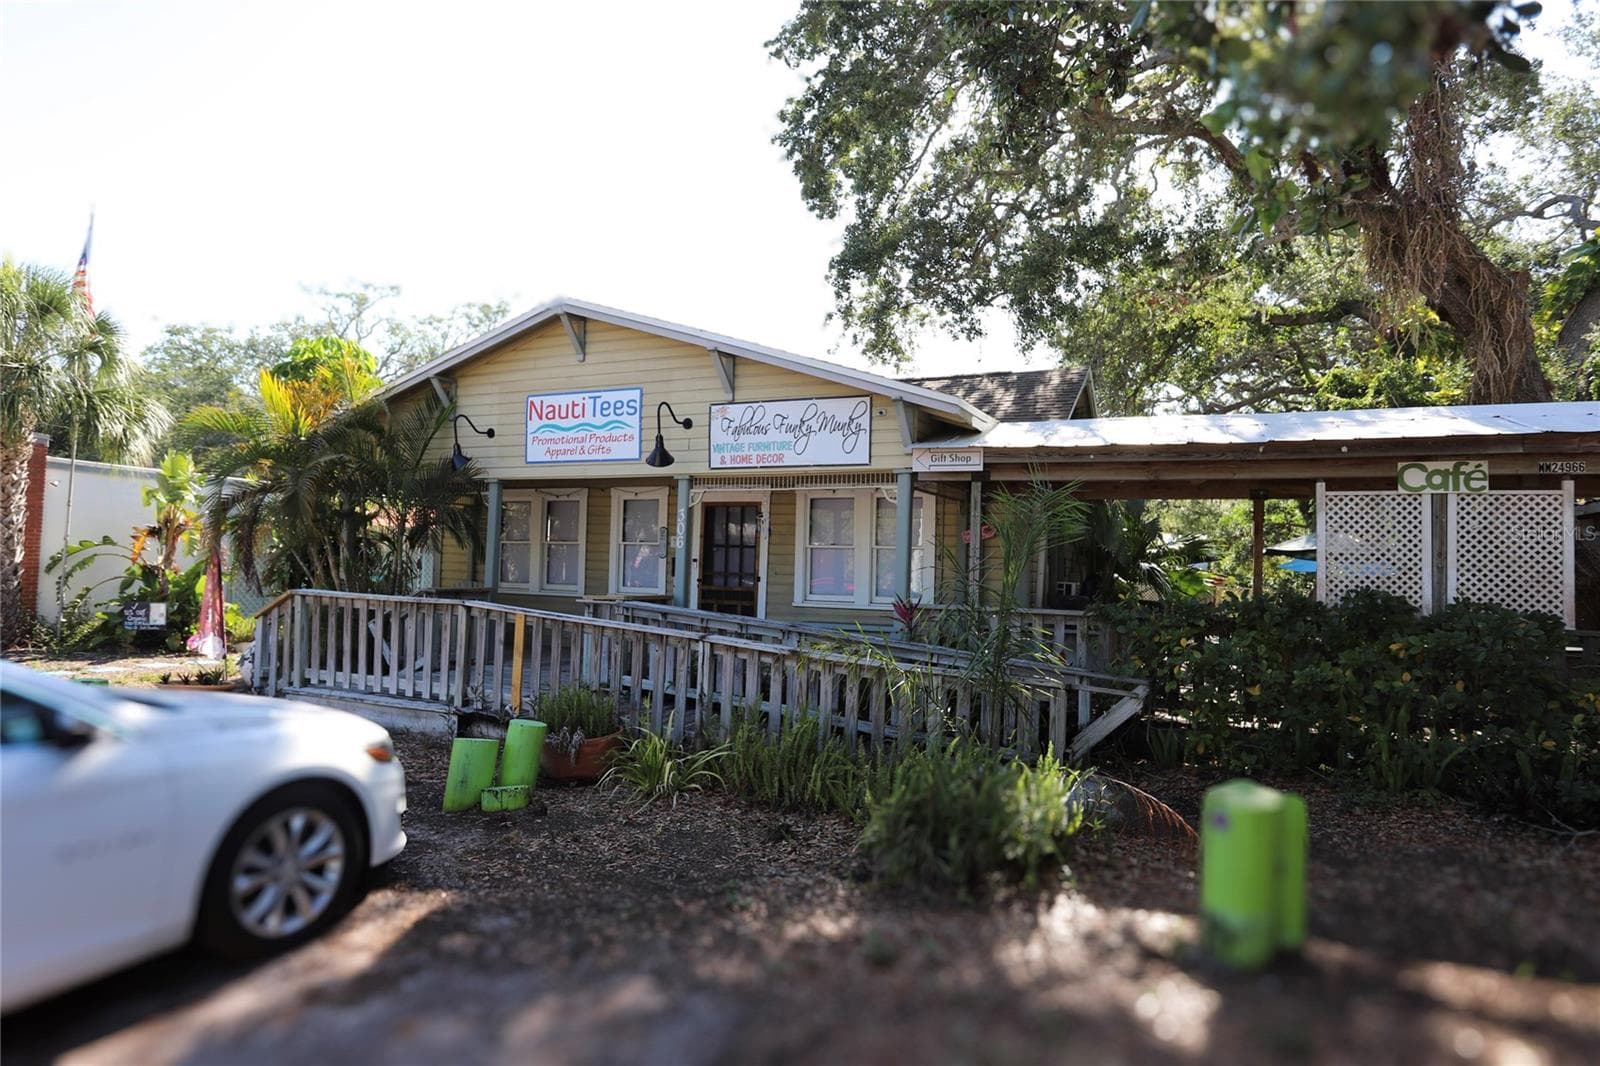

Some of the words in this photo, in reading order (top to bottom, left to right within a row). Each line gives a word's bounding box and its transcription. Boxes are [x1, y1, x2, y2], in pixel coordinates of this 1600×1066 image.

[720, 404, 773, 441] Fabulous
[773, 402, 819, 455] Funky
[816, 400, 868, 454] Munky
[531, 433, 588, 445] Promotional
[588, 432, 635, 443] Products
[544, 446, 577, 459] Apparel
[578, 446, 586, 456] &
[587, 444, 612, 455] Gifts
[712, 442, 745, 454] VINTAGE
[747, 440, 793, 452] FURNITURE
[719, 455, 727, 465] &
[730, 454, 753, 465] HOME
[756, 453, 785, 464] DECOR
[930, 453, 947, 463] Gift
[949, 453, 972, 464] Shop
[1397, 461, 1488, 492] Café
